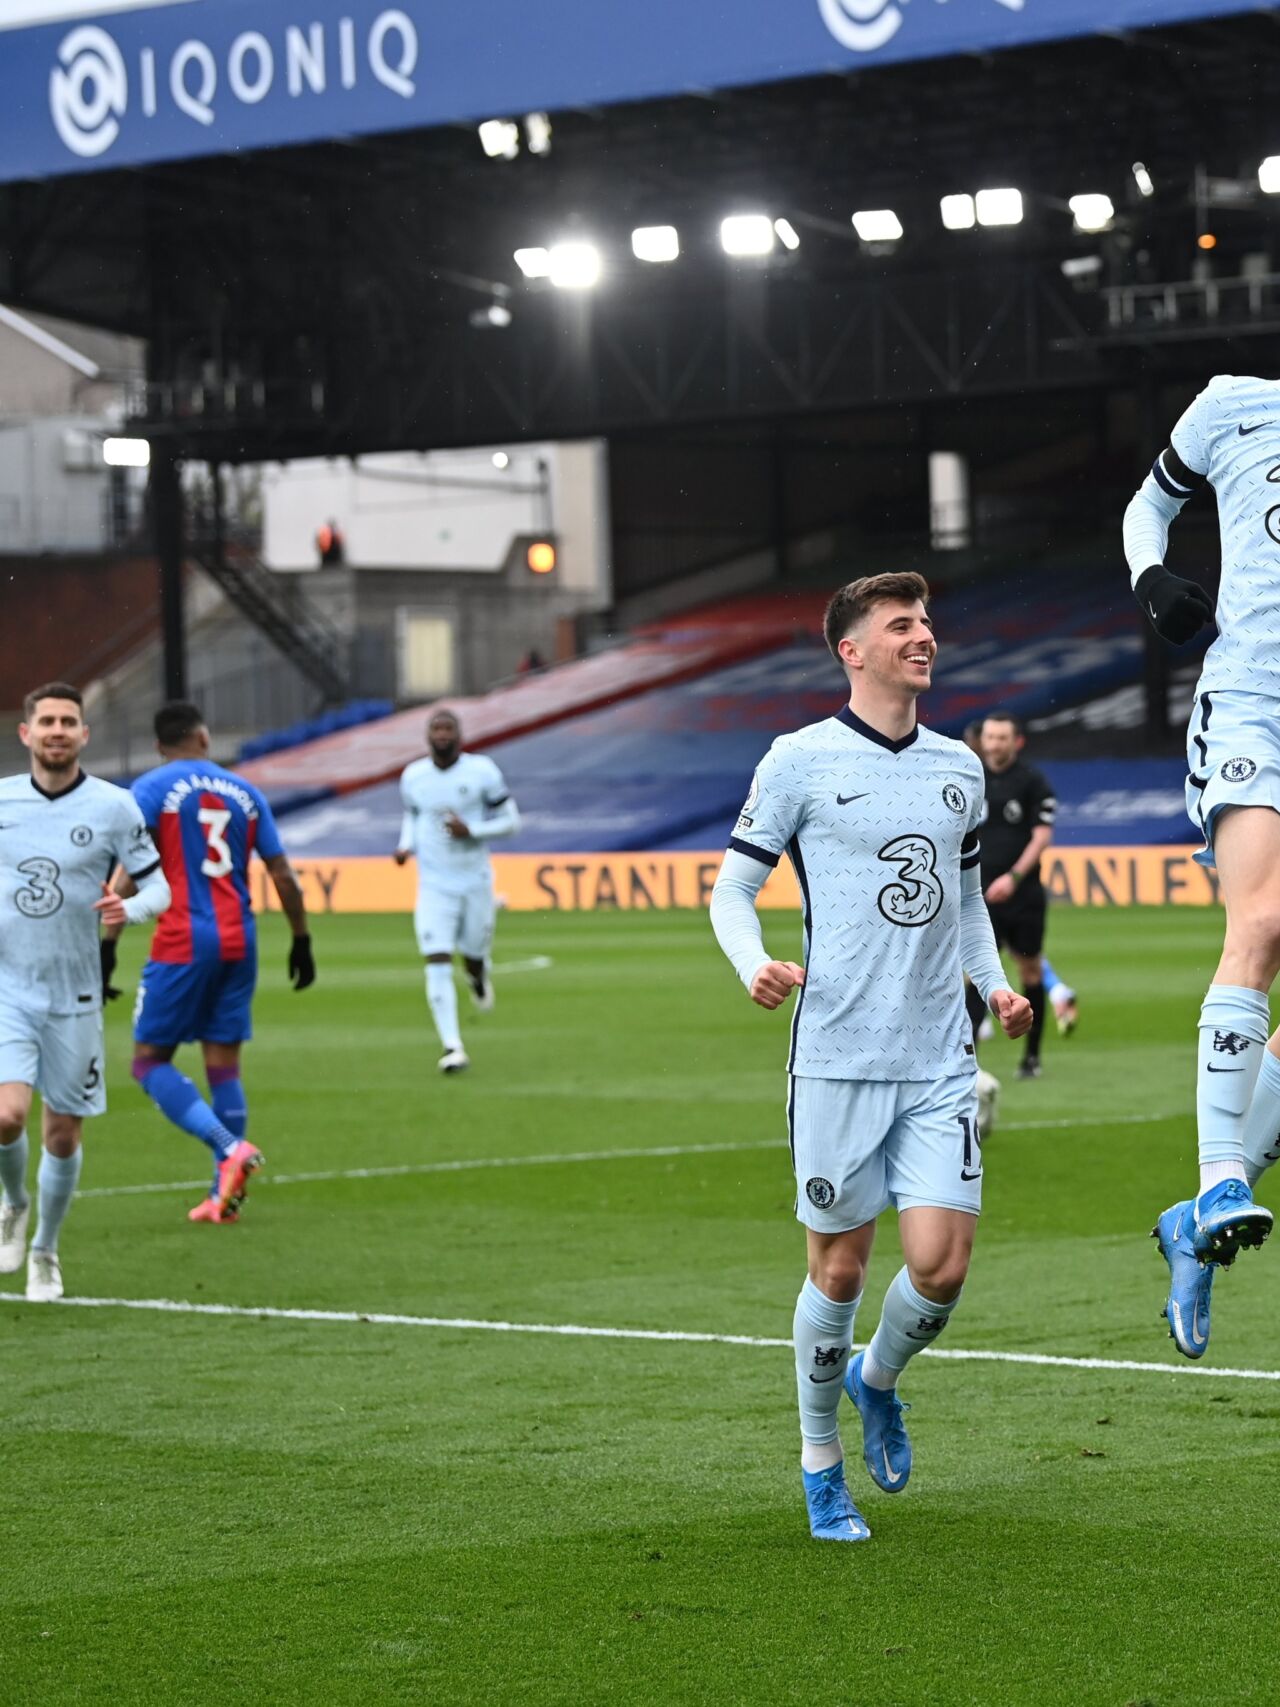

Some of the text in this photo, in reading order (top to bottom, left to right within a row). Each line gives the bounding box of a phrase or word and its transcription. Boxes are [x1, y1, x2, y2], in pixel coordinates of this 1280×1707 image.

[140, 9, 418, 126] IQONIQ
[197, 807, 234, 878] 3
[877, 833, 944, 928] 3
[536, 863, 718, 909] STANLE
